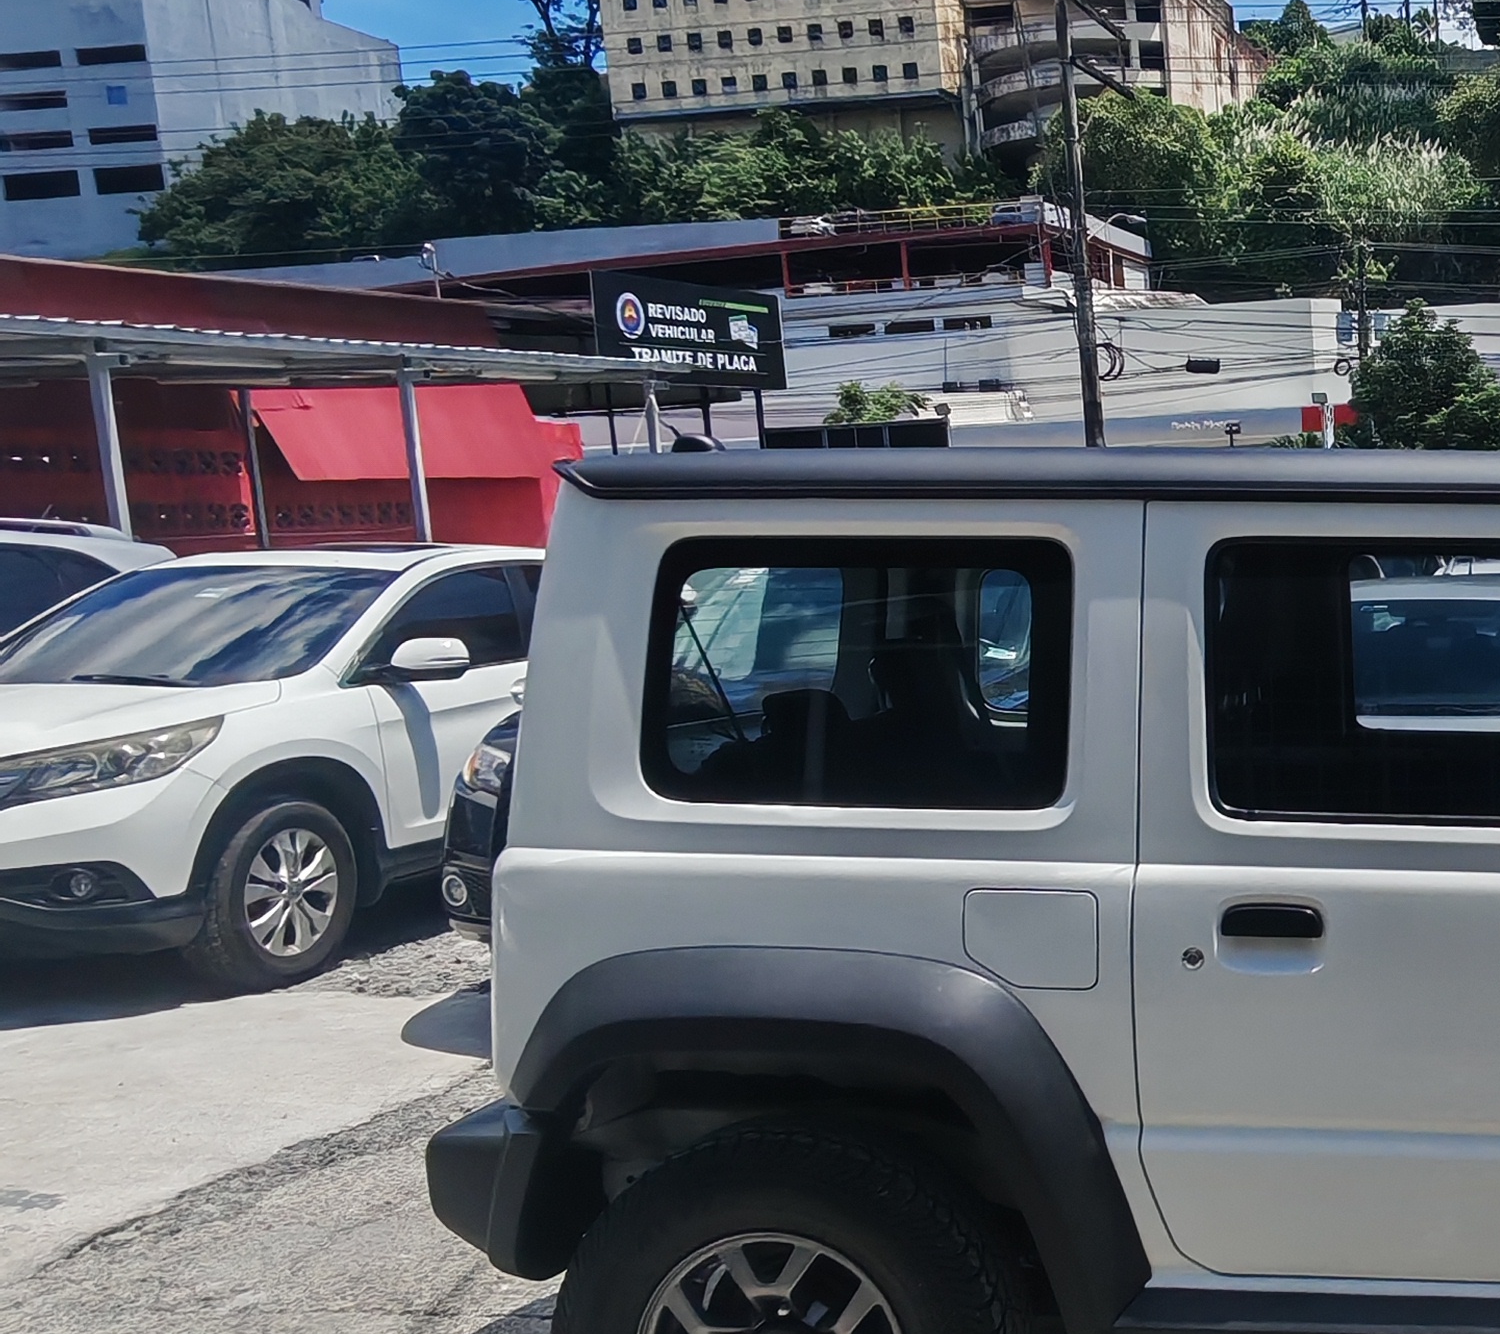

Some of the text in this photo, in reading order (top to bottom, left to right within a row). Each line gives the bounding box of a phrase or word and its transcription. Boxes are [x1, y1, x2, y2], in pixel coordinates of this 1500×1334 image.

[647, 303, 707, 324] REVISADO
[649, 323, 716, 344] VEHICULAR
[631, 347, 758, 372] TRAMITE DE PLACA
